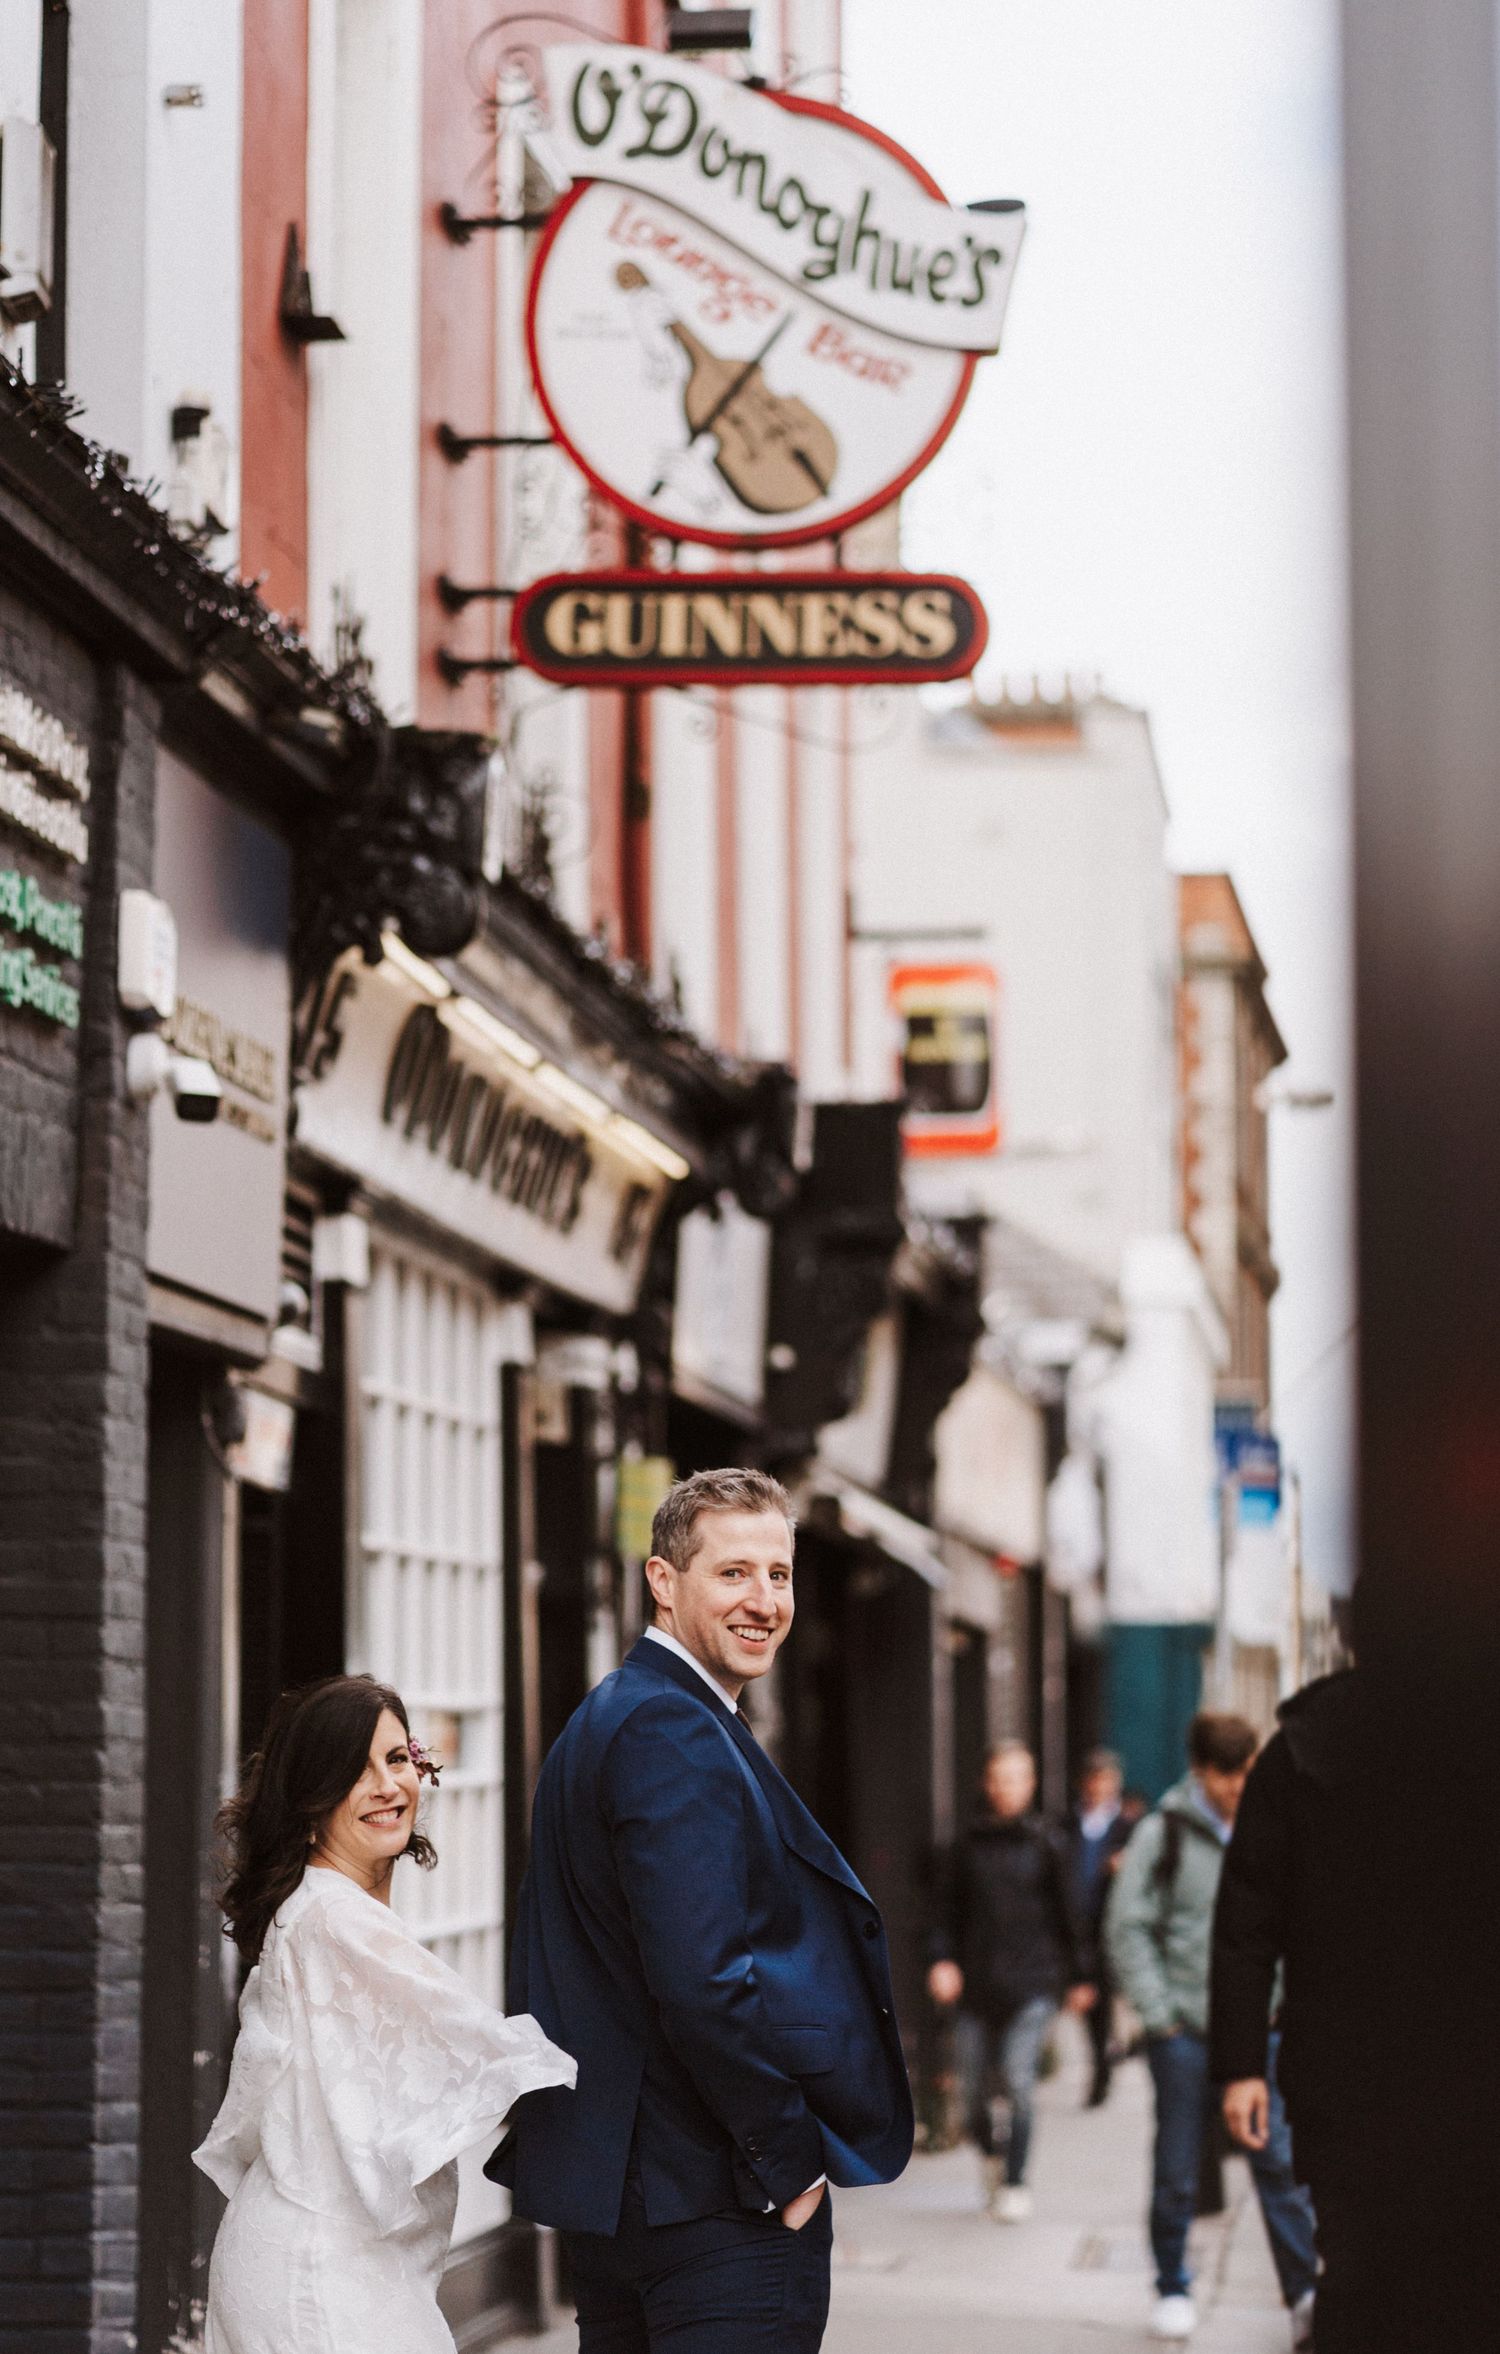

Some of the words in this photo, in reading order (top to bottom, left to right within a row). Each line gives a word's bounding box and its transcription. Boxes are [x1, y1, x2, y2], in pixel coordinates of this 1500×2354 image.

[572, 60, 1001, 308] O'Donoghue's
[609, 200, 777, 324] Lounge
[543, 587, 957, 660] GUINNESS
